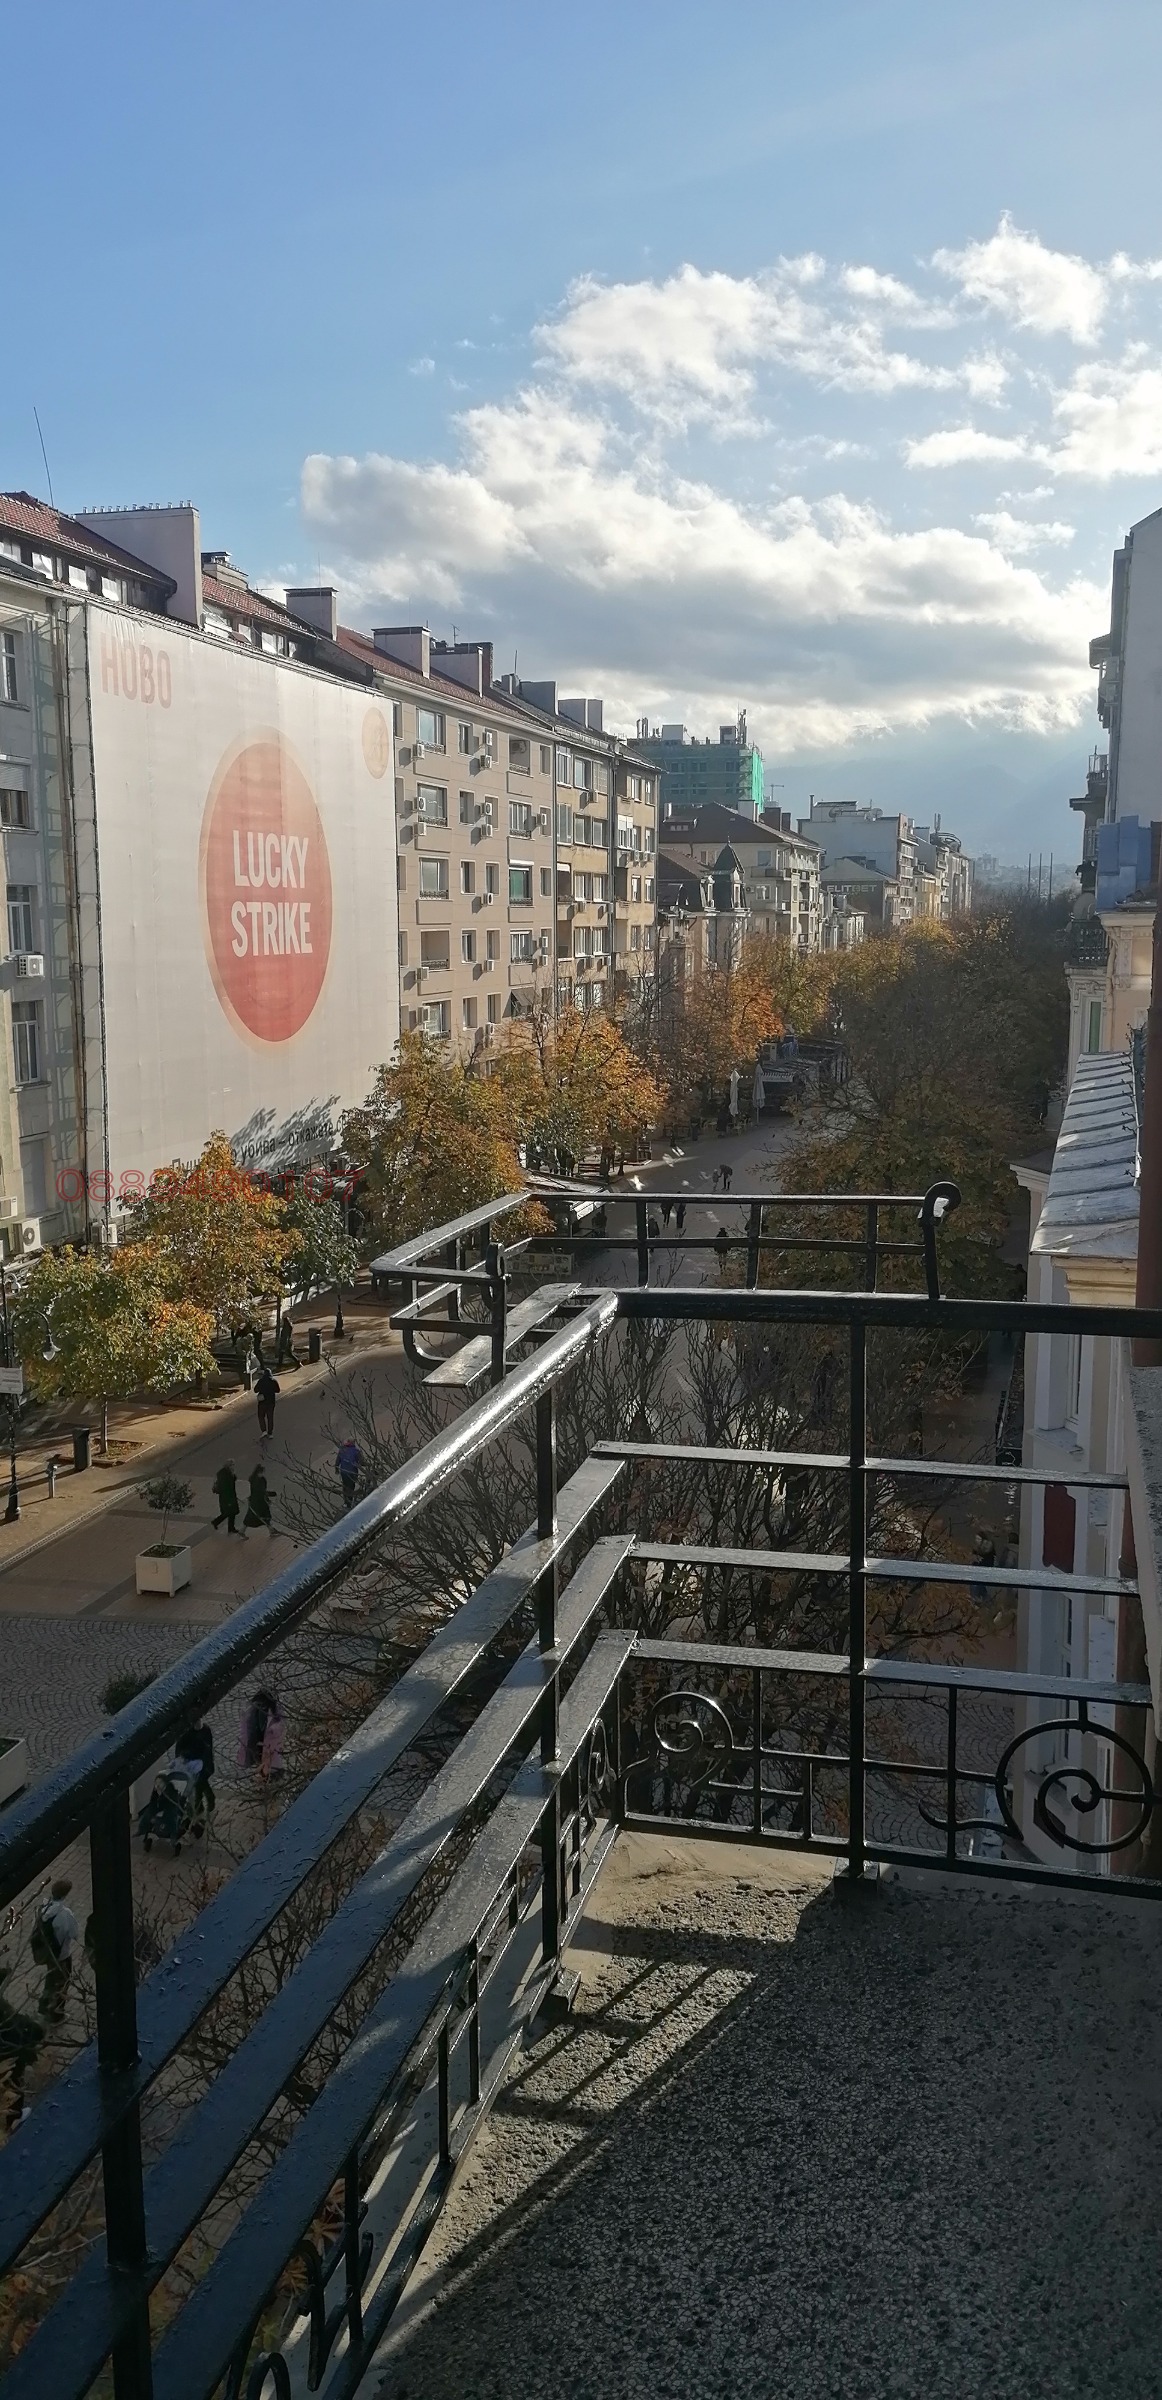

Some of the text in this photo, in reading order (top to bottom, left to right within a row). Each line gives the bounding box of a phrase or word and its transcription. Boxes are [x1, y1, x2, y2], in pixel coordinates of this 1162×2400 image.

[233, 830, 309, 888] LUCKY
[231, 901, 313, 957] STRIKE
[241, 1137, 276, 1165] убива
